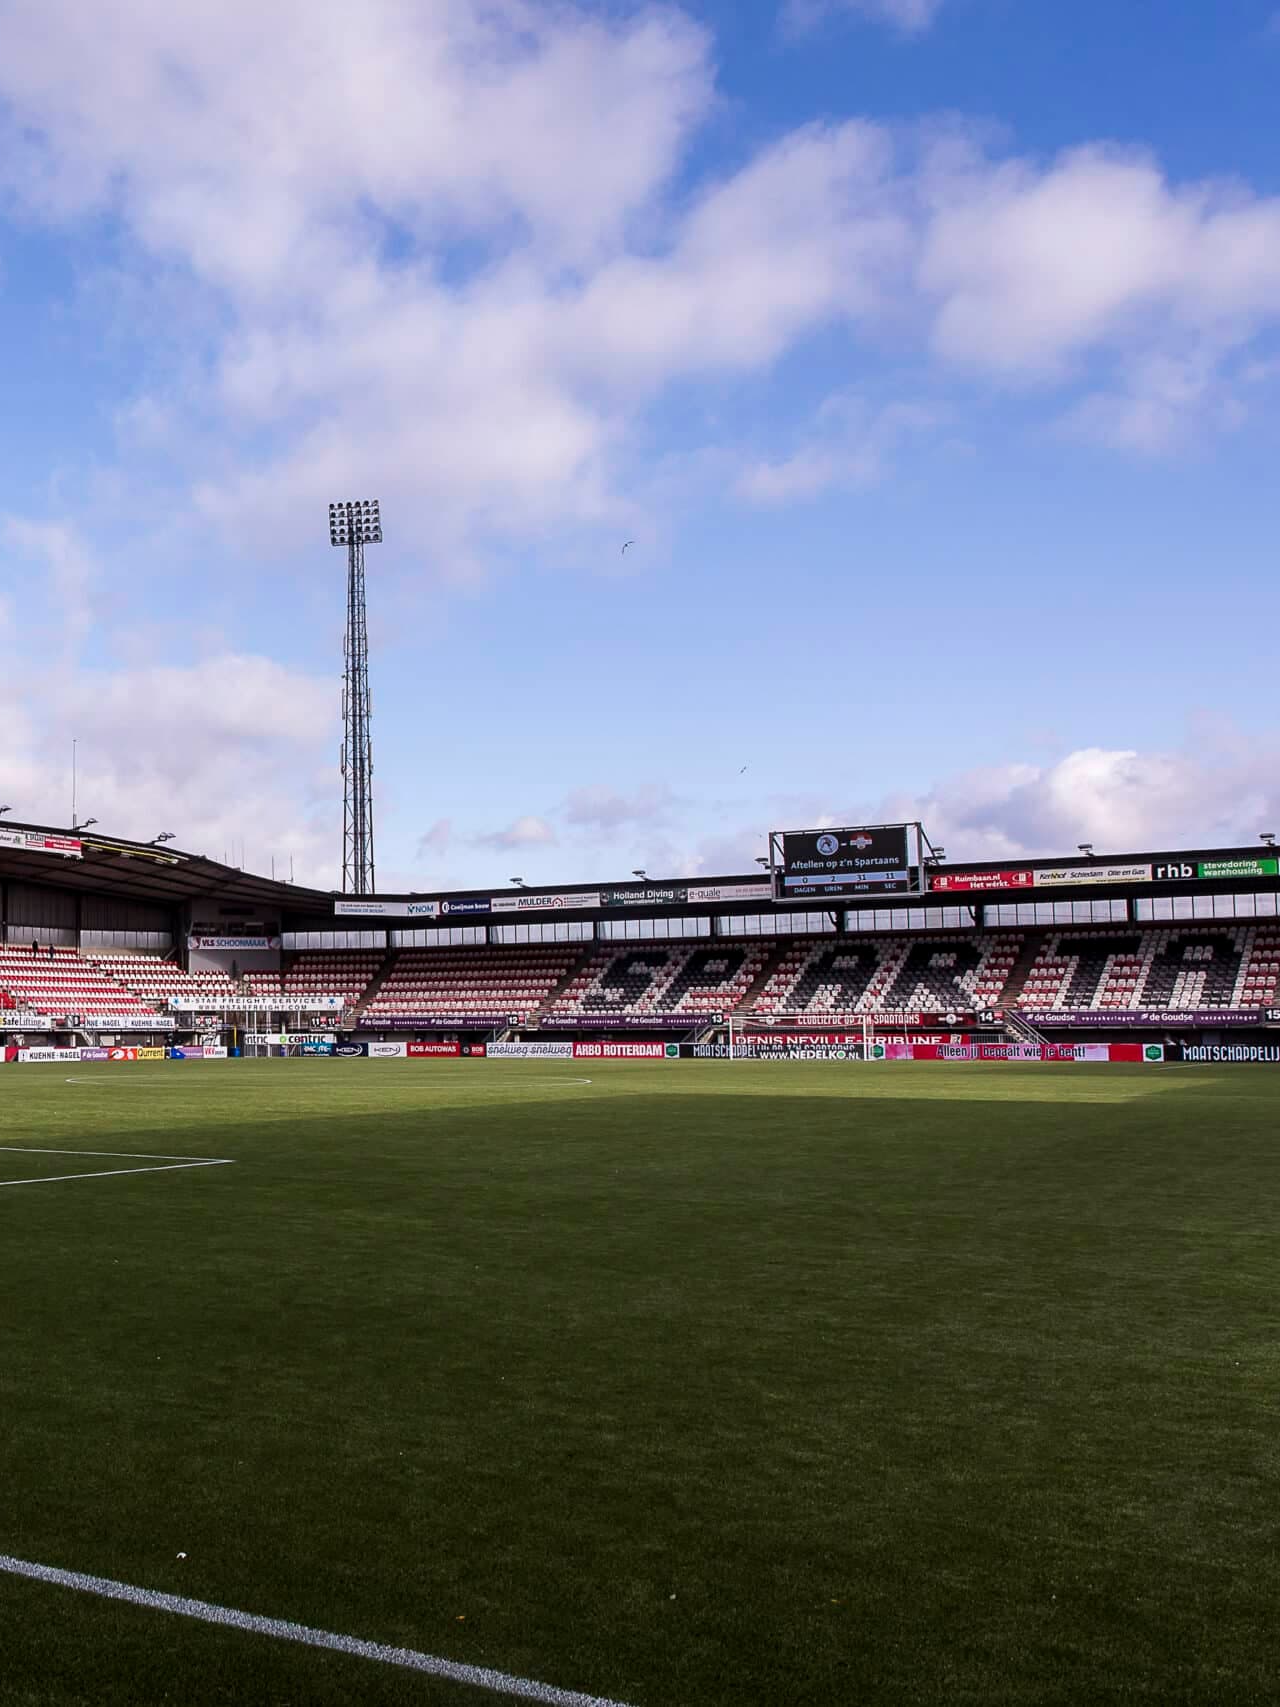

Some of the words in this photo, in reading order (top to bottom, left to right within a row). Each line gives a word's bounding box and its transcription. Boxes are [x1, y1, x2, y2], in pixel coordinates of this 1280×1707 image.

[791, 861, 824, 870] Aftellen
[826, 861, 837, 869] op
[839, 859, 853, 867] z'n
[855, 857, 899, 867] Spartaans
[1203, 860, 1257, 869] stevedoring
[1157, 864, 1193, 878] rhb
[1204, 867, 1263, 876] warehousing
[955, 874, 1000, 883] Ruimbaan.nl
[613, 890, 645, 900] Holland
[647, 889, 674, 899] Diving
[518, 897, 552, 906] MULDER
[415, 905, 434, 913] NOM
[202, 938, 214, 948] VLS
[711, 1014, 722, 1023] 13
[980, 1012, 992, 1022] 14
[1034, 1013, 1043, 1021] de
[1044, 1013, 1075, 1021] Goudse
[1149, 1012, 1160, 1021] de
[1162, 1012, 1193, 1021] Goudse
[1266, 1010, 1280, 1019] 15
[508, 1014, 518, 1025] 12
[874, 1014, 920, 1025] SPARTAANS
[288, 1034, 325, 1043] centric
[736, 1036, 783, 1045] DENIS
[576, 1044, 601, 1057] ARBO
[603, 1044, 663, 1057] ROTTERDAM
[760, 1051, 859, 1059] WWW.NEDELKO.NL
[936, 1044, 967, 1057] Alleen
[984, 1044, 1020, 1059] bepaalt
[1024, 1044, 1042, 1057] wie
[1046, 1044, 1055, 1059] je
[1059, 1044, 1086, 1057] bent!
